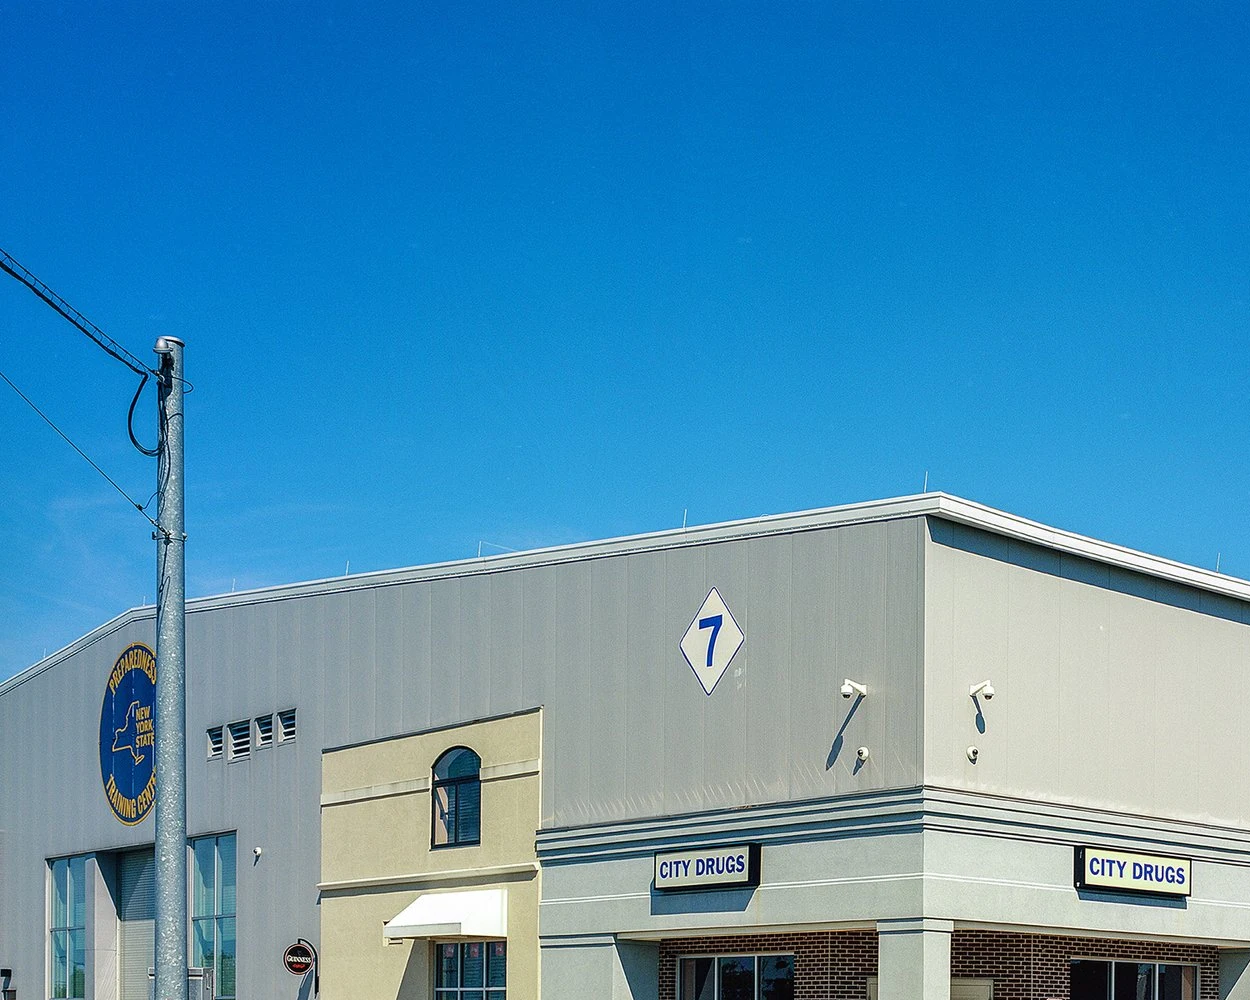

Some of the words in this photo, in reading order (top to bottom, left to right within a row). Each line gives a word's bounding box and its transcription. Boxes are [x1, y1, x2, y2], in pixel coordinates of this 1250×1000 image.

[698, 614, 723, 668] 7
[109, 649, 157, 695] PREPAREDNESS
[136, 706, 150, 721] NEW
[136, 719, 153, 735] YORK
[136, 732, 155, 748] STATE
[106, 774, 137, 818] TRAINING
[138, 766, 157, 814] CENT
[660, 860, 692, 879] CITY
[696, 854, 745, 876] DRUGS
[1089, 857, 1127, 879] CITY
[1132, 862, 1186, 885] DRUGS
